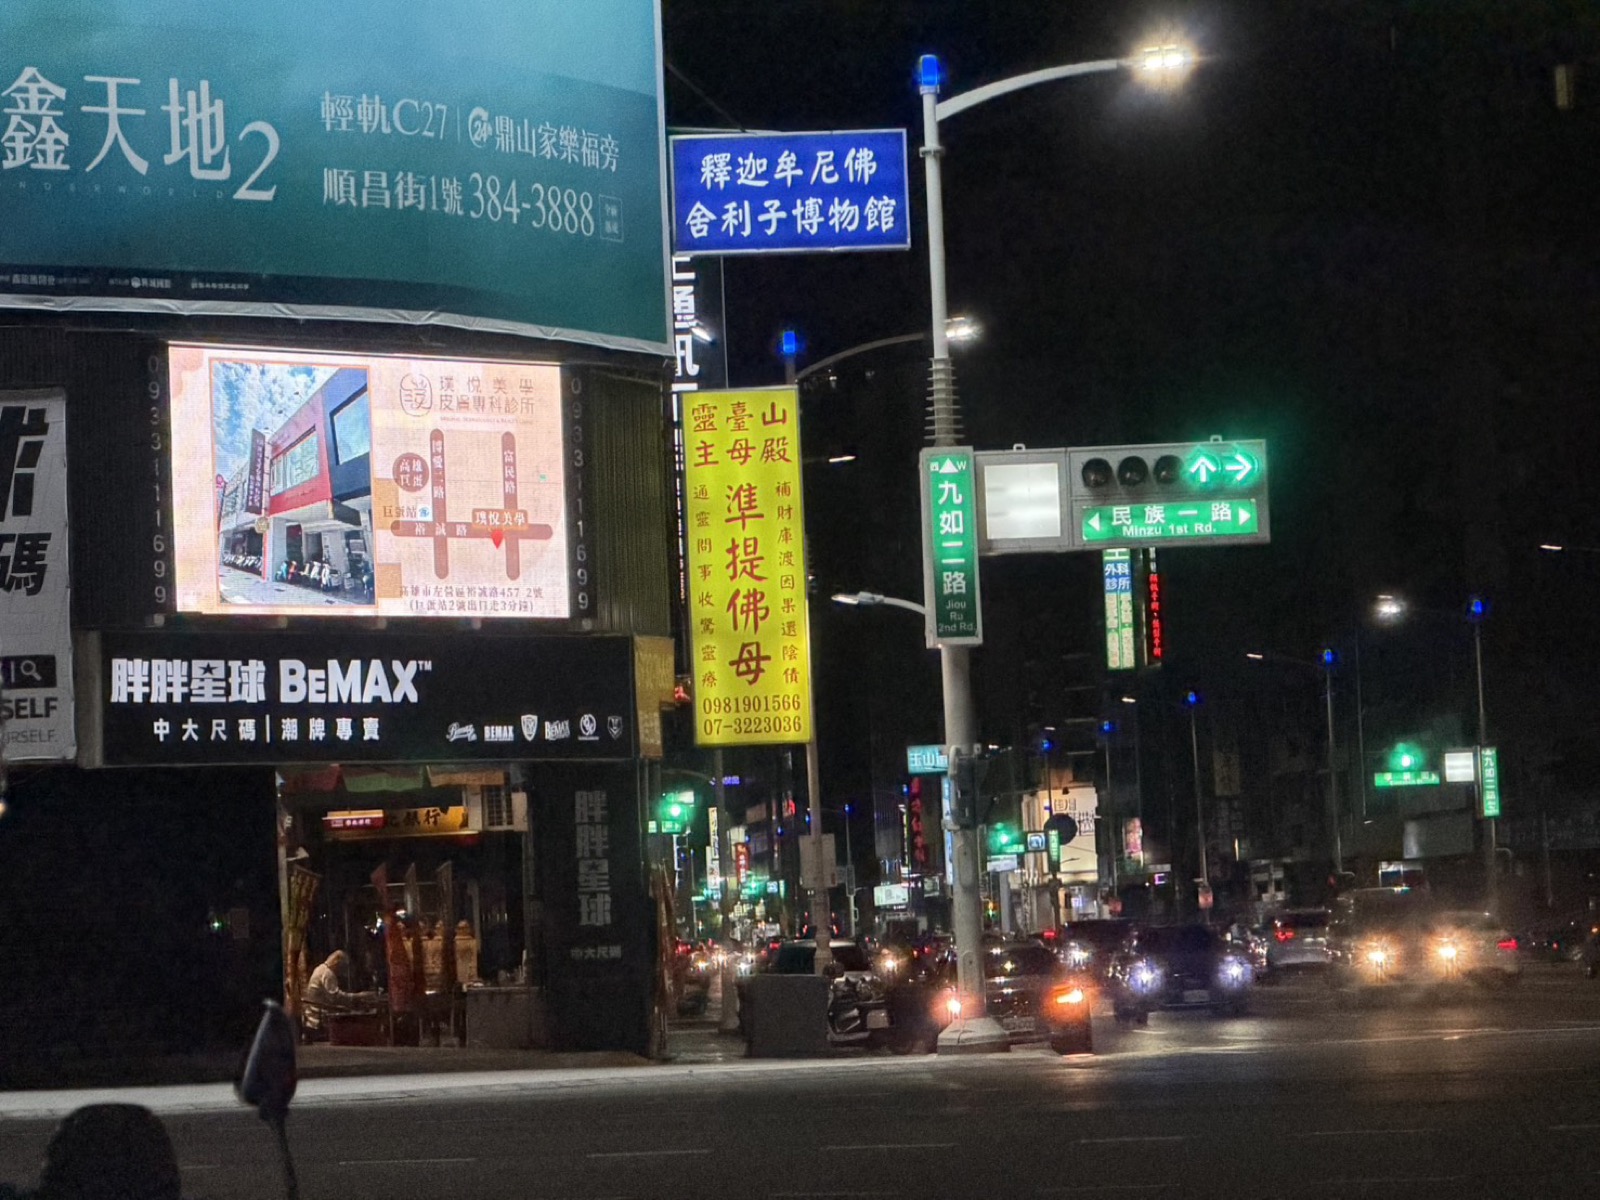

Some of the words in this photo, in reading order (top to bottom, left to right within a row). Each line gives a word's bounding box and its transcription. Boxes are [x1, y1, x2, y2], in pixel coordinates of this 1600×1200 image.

[321, 91, 448, 140] 輕軌C27
[495, 116, 620, 173] 鼎山家樂福旁
[700, 147, 877, 190] 釋迦牟尼佛
[323, 168, 464, 216] 順昌街1號
[469, 172, 595, 237] 384-3888
[686, 196, 896, 238] 舍利子博物館
[692, 401, 787, 432] 靈臺山
[693, 436, 792, 466] 主母殿
[956, 461, 967, 471] W
[1111, 502, 1232, 526] 民族一路
[937, 480, 967, 595] 九如二路
[1122, 524, 1162, 537] Minzu
[1169, 523, 1188, 535] 1st
[1195, 522, 1216, 533] Rd.
[724, 482, 772, 686] 準提佛母
[1105, 563, 1130, 576] 外科
[1105, 576, 1131, 590] 診所
[945, 600, 967, 610] Jiou
[111, 658, 267, 703] 胖胖星球
[703, 694, 801, 715] 0981901566
[153, 718, 256, 741] 中大尺碼
[282, 718, 380, 741] 潮牌專賣
[704, 715, 802, 736] 07-3223036
[574, 790, 612, 926] 胖胖星球
